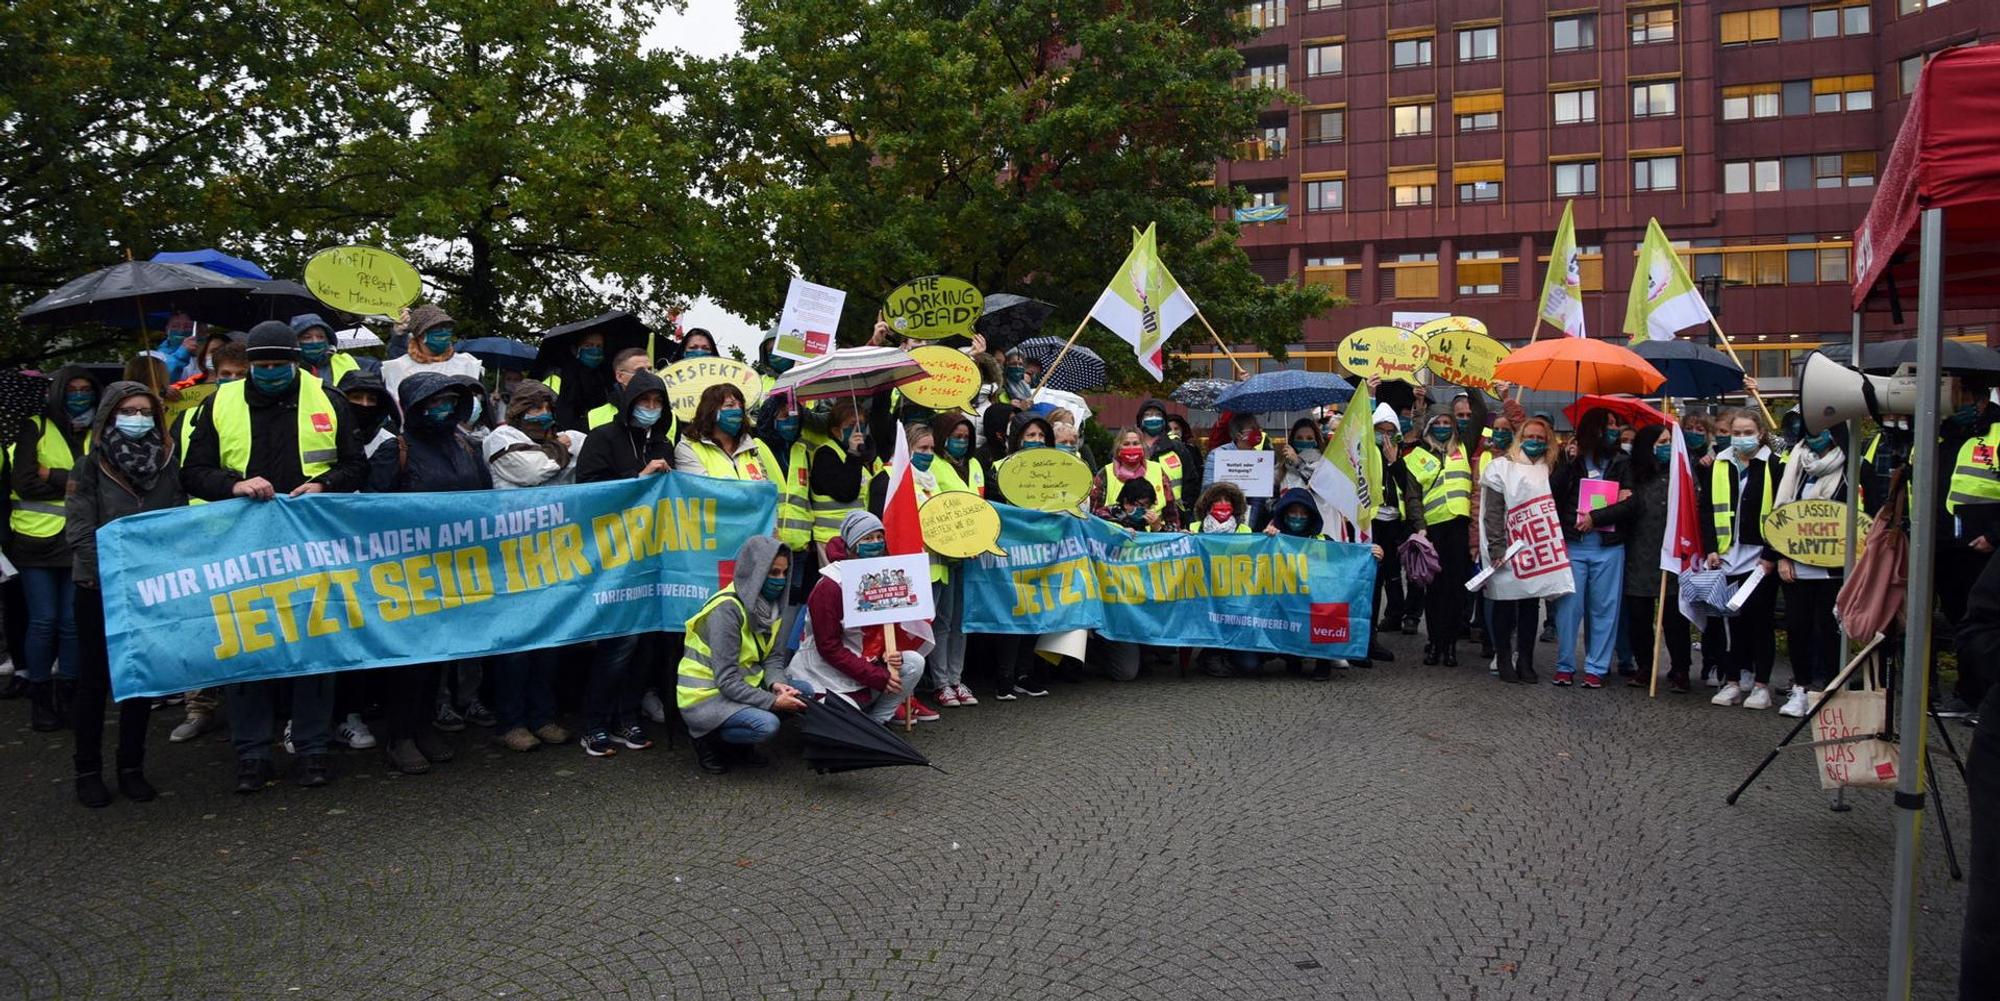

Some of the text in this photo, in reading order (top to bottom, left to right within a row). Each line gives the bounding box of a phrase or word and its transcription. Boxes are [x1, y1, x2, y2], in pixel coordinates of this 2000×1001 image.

[908, 277, 938, 294] THE
[884, 287, 974, 318] WORKING
[1350, 337, 1371, 351] Was
[1375, 356, 1416, 375] Applaus
[1509, 501, 1556, 528] WEIL ES
[1768, 503, 1872, 535] WIR LASSEN NS
[1797, 522, 1840, 537] NICHT
[137, 502, 570, 608] WIR HALTEN DEN LADEN AM LAUFEN.
[209, 497, 717, 661] JETZT SEID IHR DRAN!
[1012, 556, 1097, 616] JETZT
[1148, 556, 1209, 602] IHR
[1210, 553, 1311, 597] DRAN!
[656, 583, 697, 598] PWERED
[697, 586, 710, 600] BY
[1208, 612, 1253, 626] TFRUNDE
[1289, 621, 1303, 632] BY
[1313, 627, 1347, 638] ver.di
[1818, 707, 1844, 728] ICH
[1824, 744, 1856, 763] WAS
[1826, 763, 1849, 784] BEI
